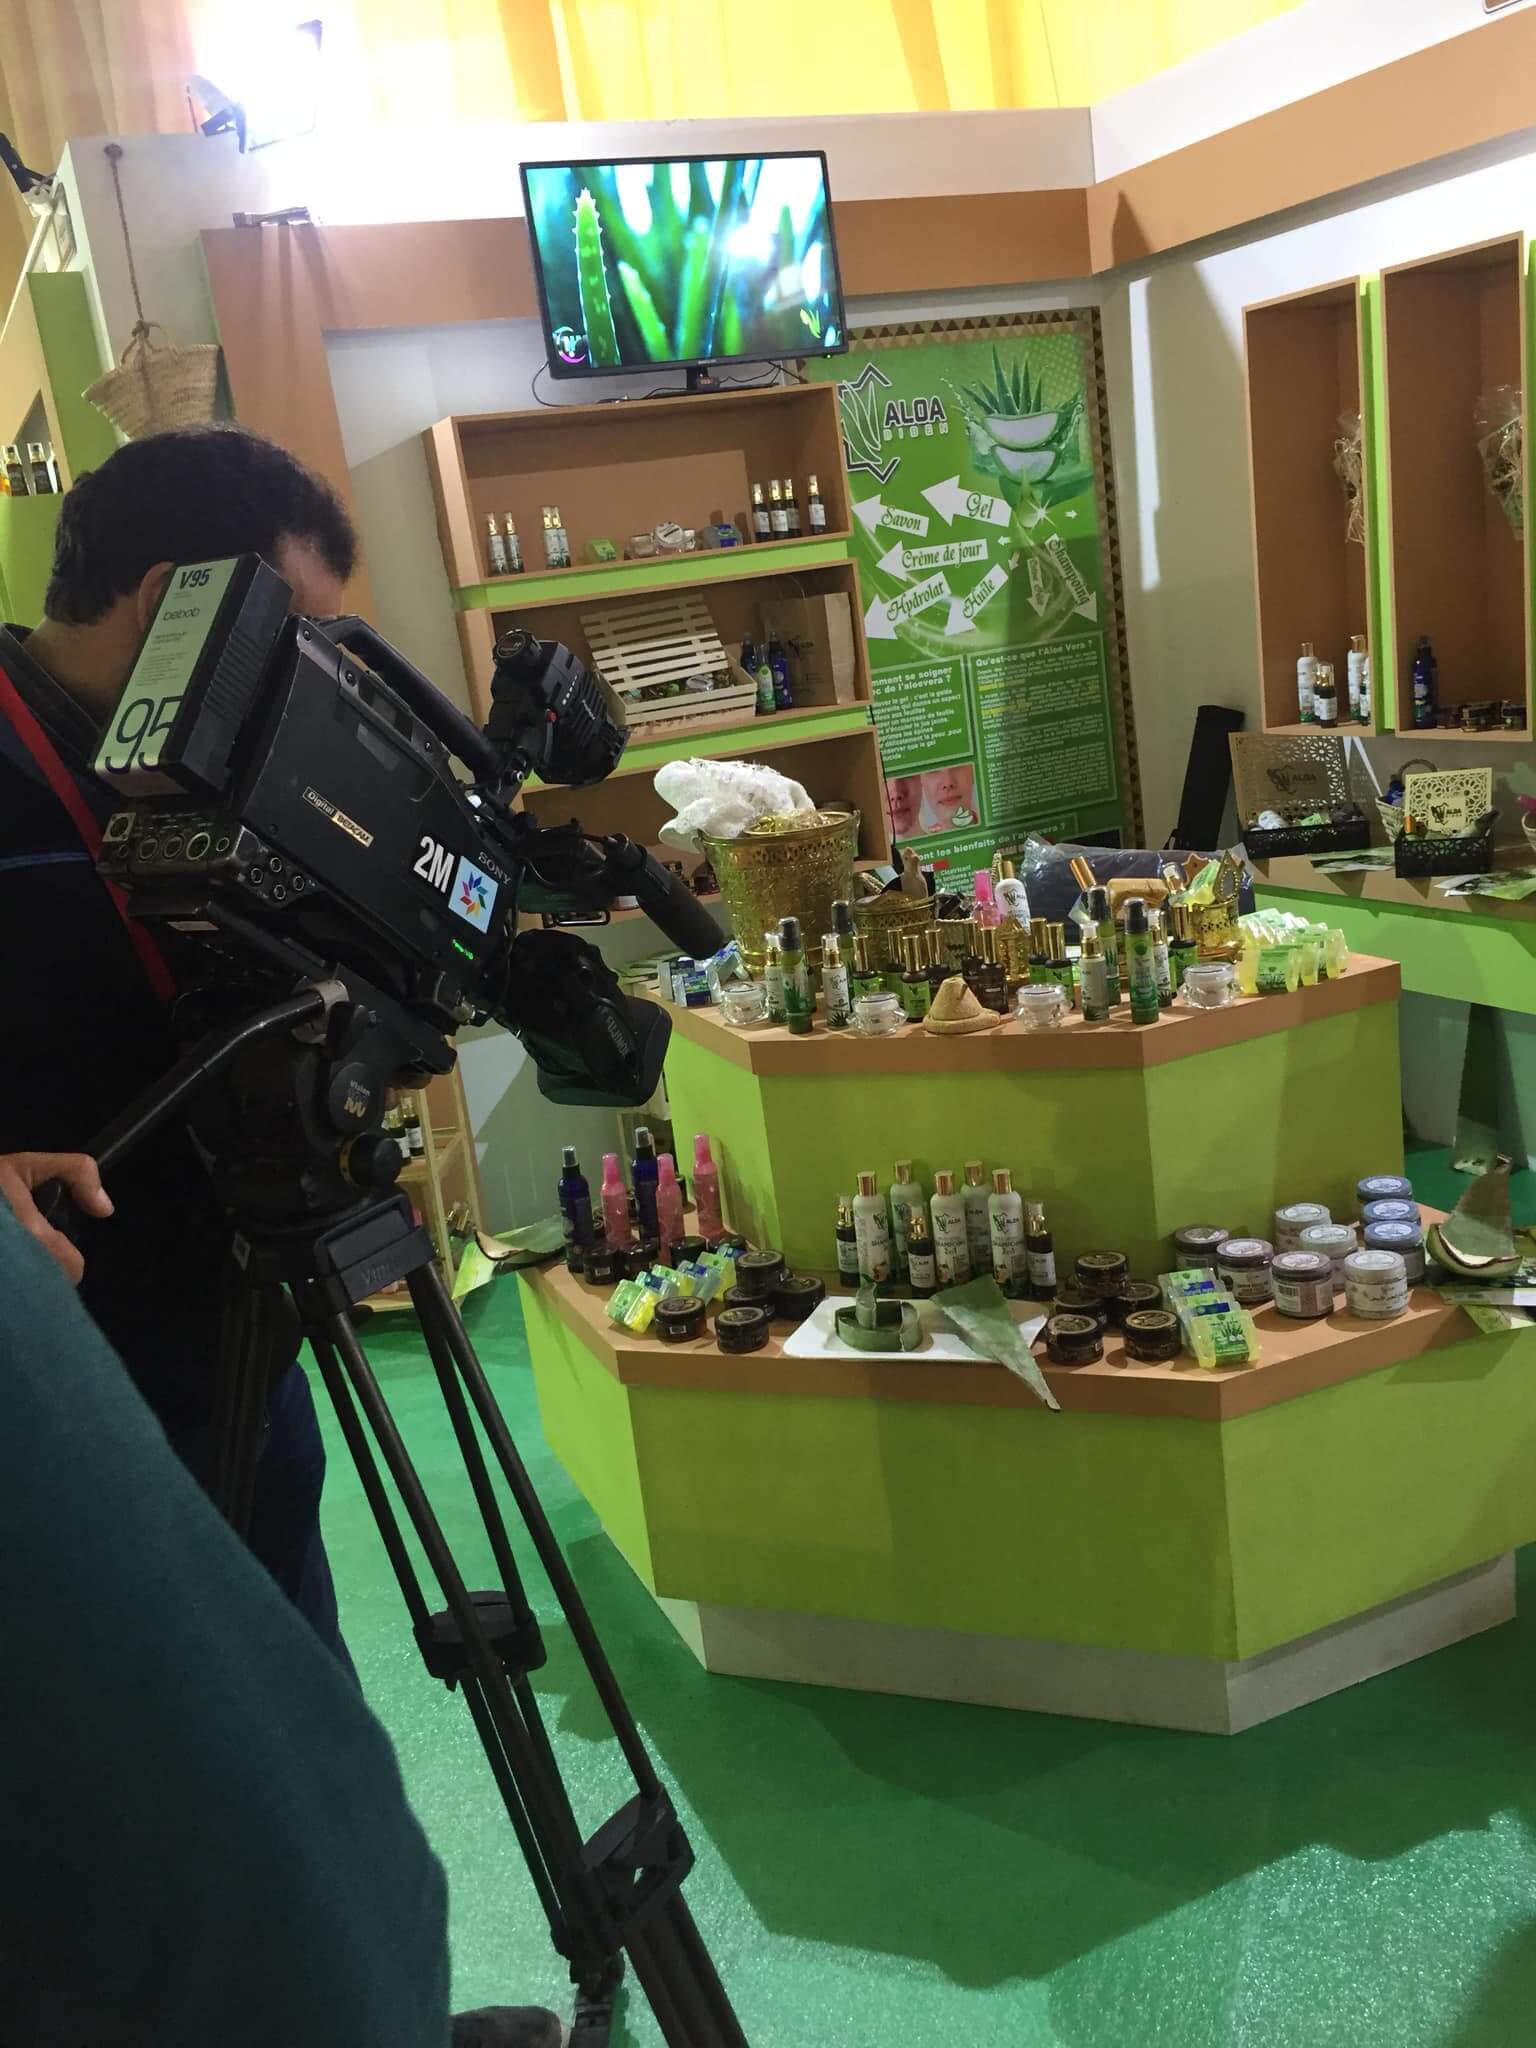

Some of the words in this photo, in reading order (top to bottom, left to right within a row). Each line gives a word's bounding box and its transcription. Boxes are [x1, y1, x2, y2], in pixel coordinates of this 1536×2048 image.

[883, 395, 947, 428] ALOA
[880, 505, 922, 531] Savon
[966, 492, 995, 520] Gel
[901, 550, 939, 569] Crème
[943, 546, 955, 561] de
[955, 542, 982, 568] jour
[179, 568, 213, 589] V95
[1048, 537, 1091, 608] Shampoing
[886, 581, 944, 621] Hydrolat
[962, 579, 996, 619] Huile
[163, 607, 201, 622] bebob
[976, 655, 1018, 667] Qu'est-ce
[872, 674, 903, 687] mment
[104, 696, 184, 775] 95
[307, 790, 335, 816] Digital
[919, 851, 934, 861] ont
[954, 839, 996, 853] bienfaits
[412, 835, 456, 893] 2M
[478, 851, 512, 886] SONY
